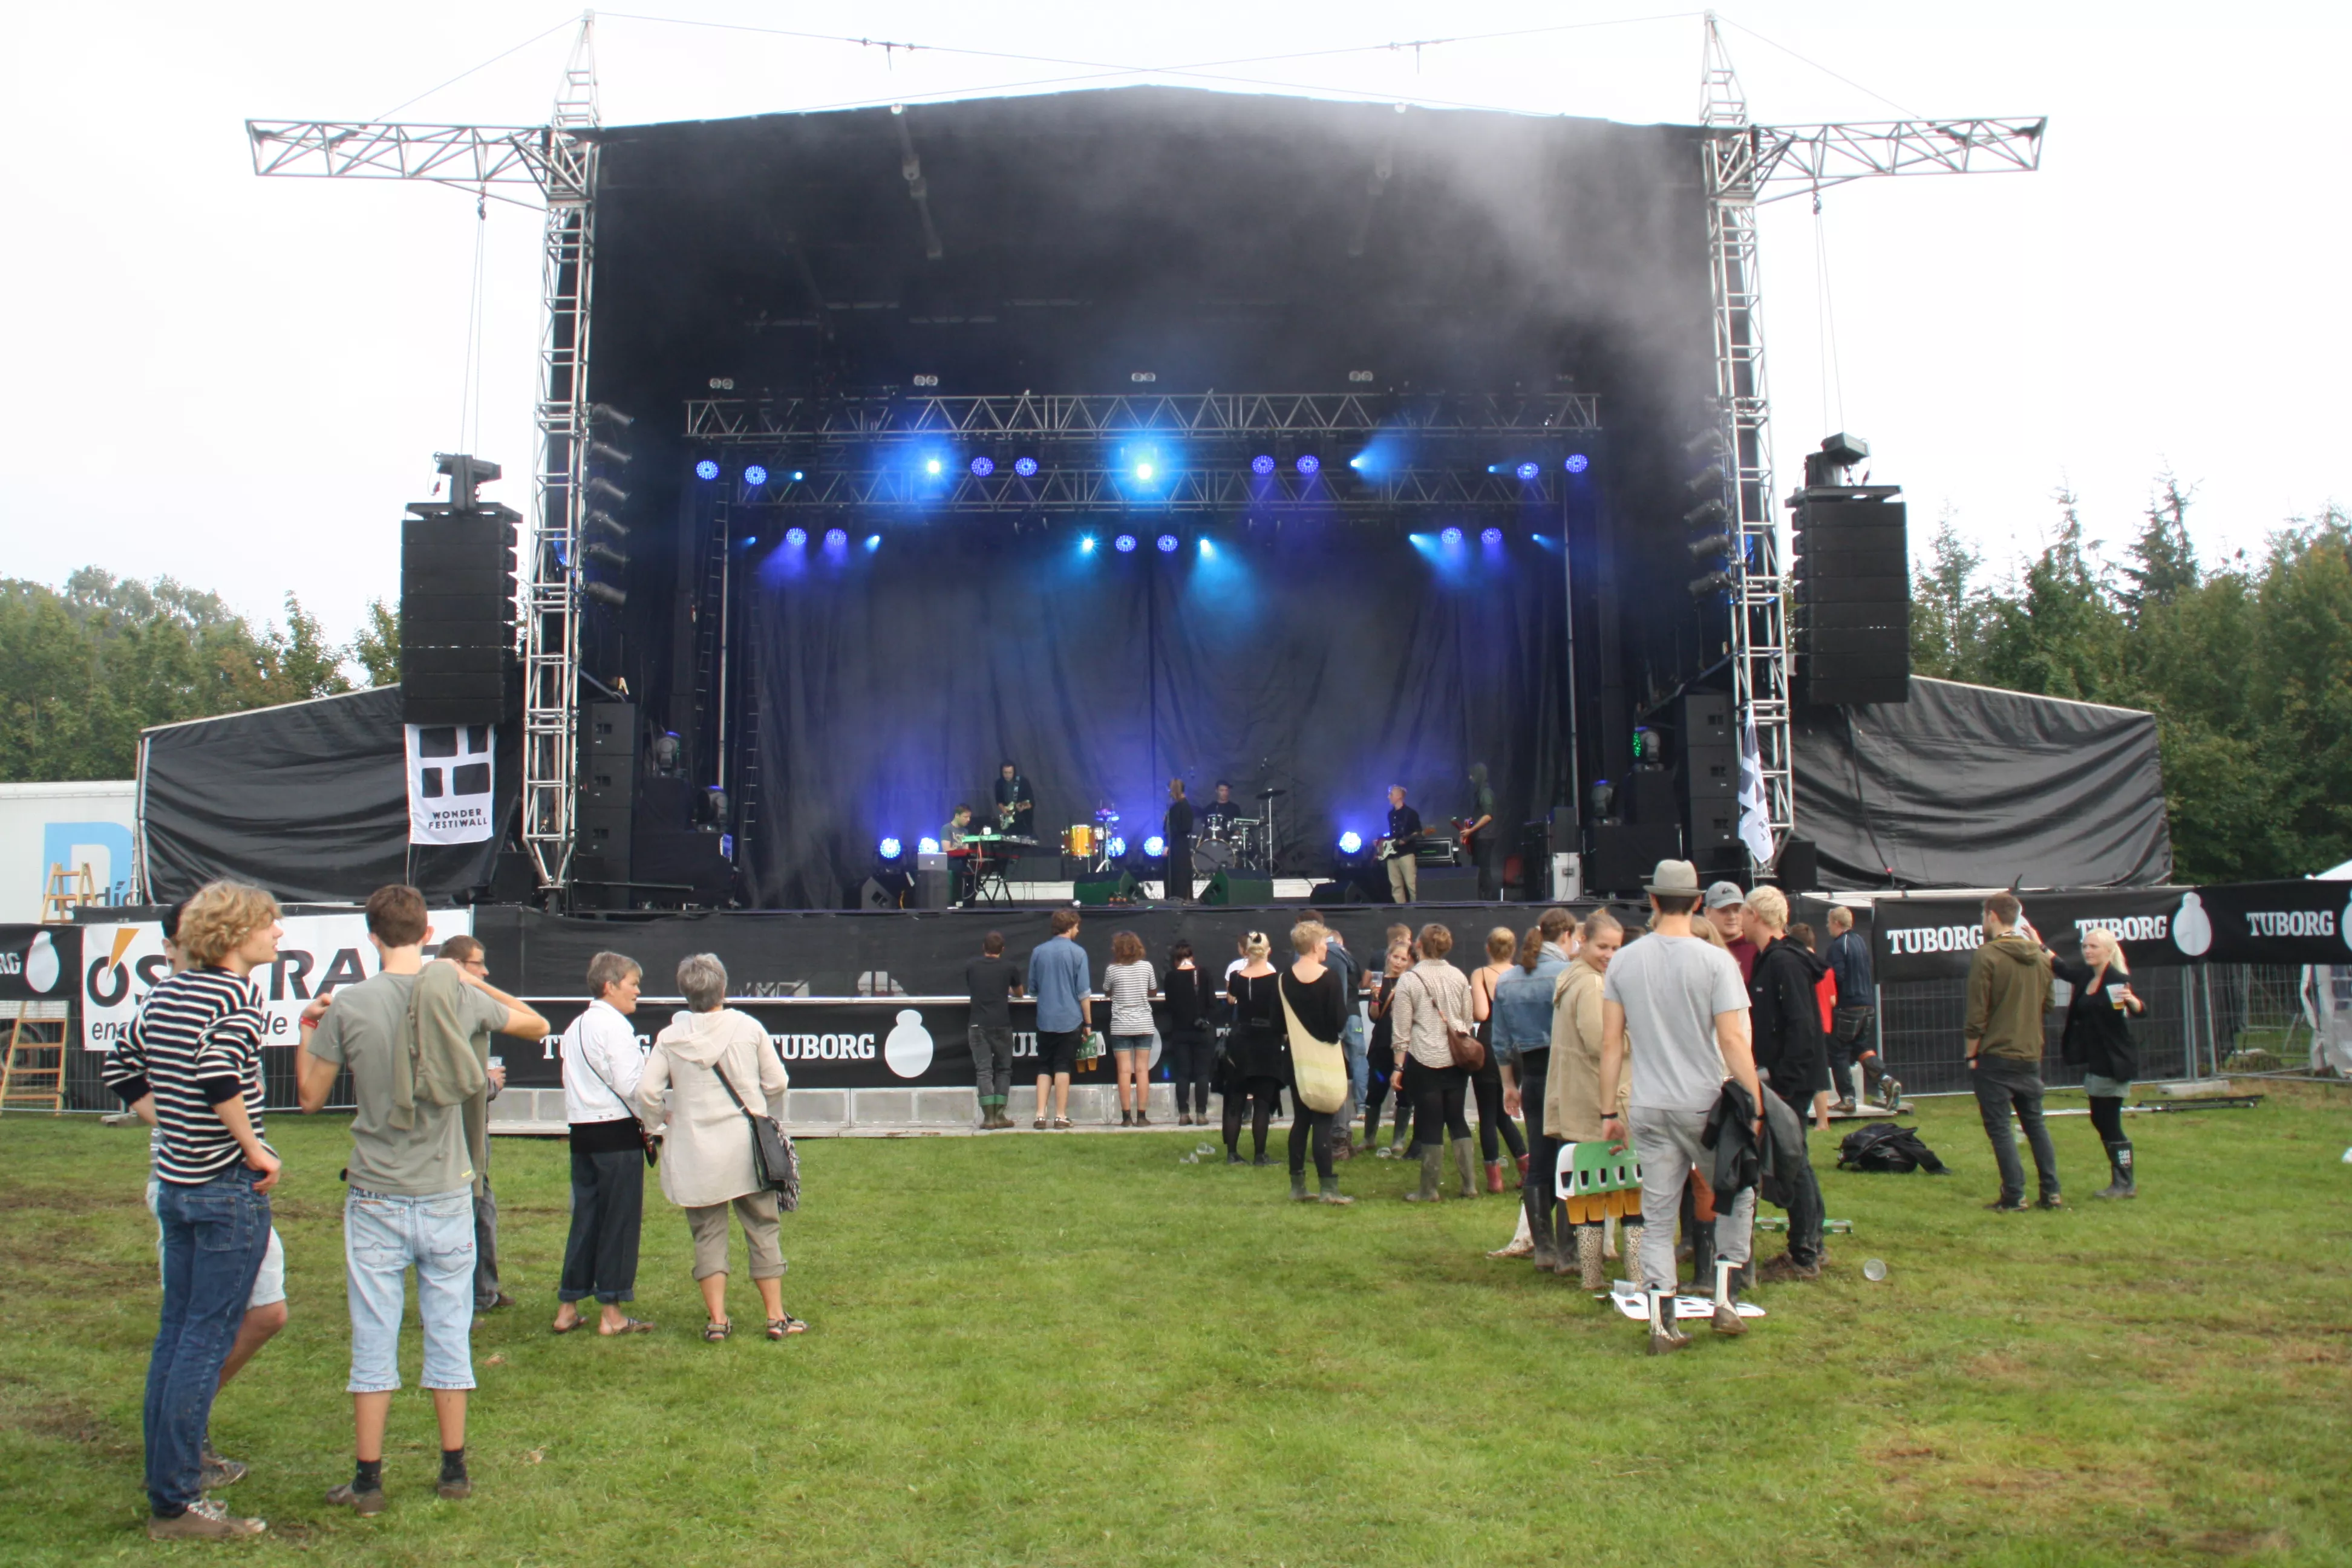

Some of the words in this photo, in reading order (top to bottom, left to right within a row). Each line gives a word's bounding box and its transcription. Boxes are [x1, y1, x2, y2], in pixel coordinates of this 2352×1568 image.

[433, 808, 482, 819] WONDER
[428, 817, 488, 829] FESTIWALL
[2246, 911, 2334, 936] TUBORG
[1887, 925, 1984, 954] TUBORG
